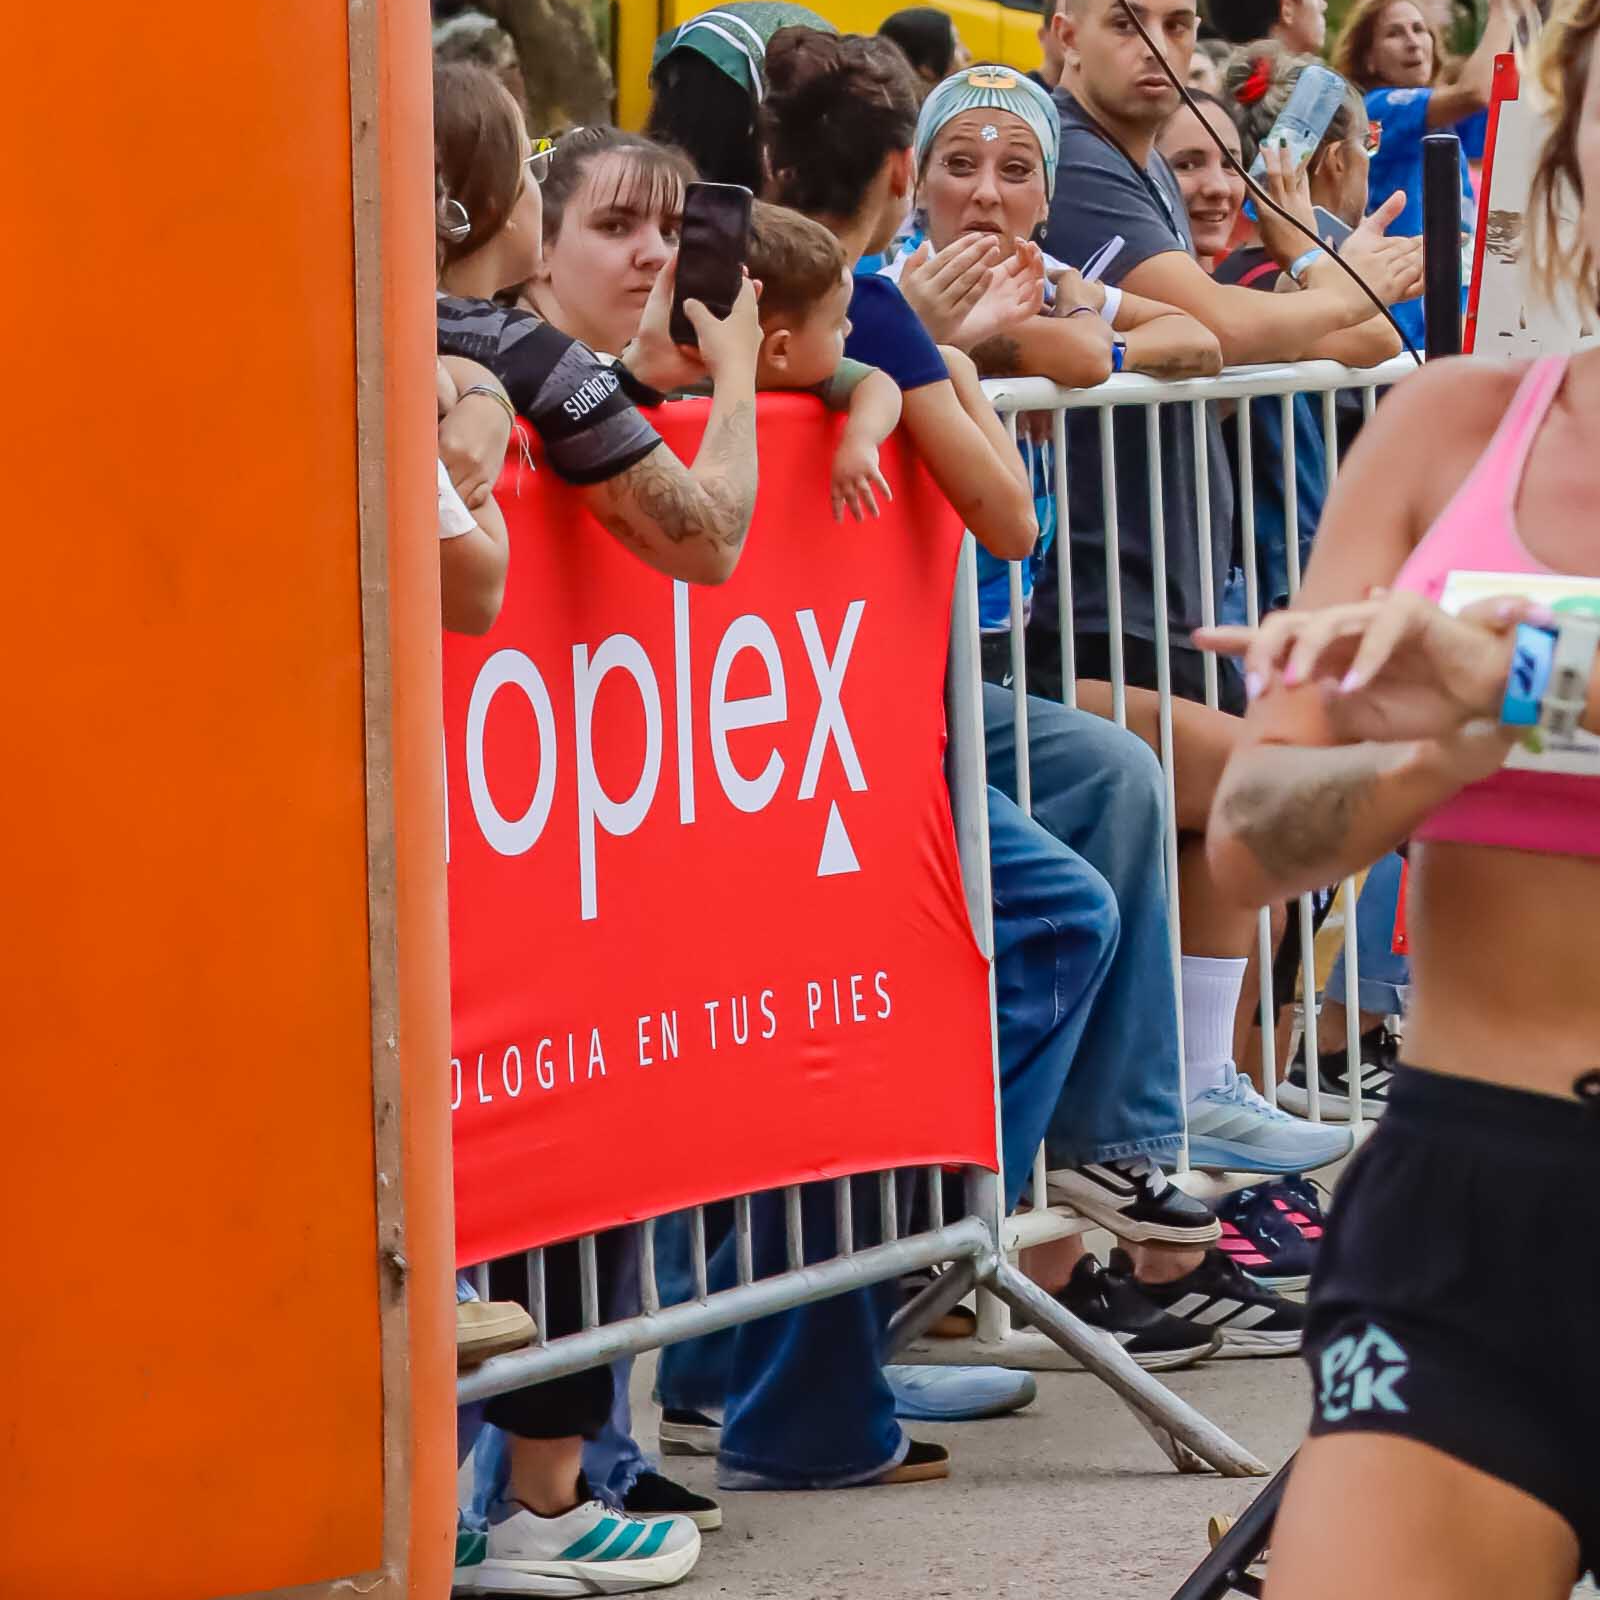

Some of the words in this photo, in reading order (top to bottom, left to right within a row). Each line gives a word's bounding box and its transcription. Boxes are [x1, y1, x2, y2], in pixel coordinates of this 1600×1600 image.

[443, 579, 869, 920] oplex
[637, 1009, 680, 1067] EN
[704, 989, 777, 1050] TUS
[807, 970, 892, 1029] PIES
